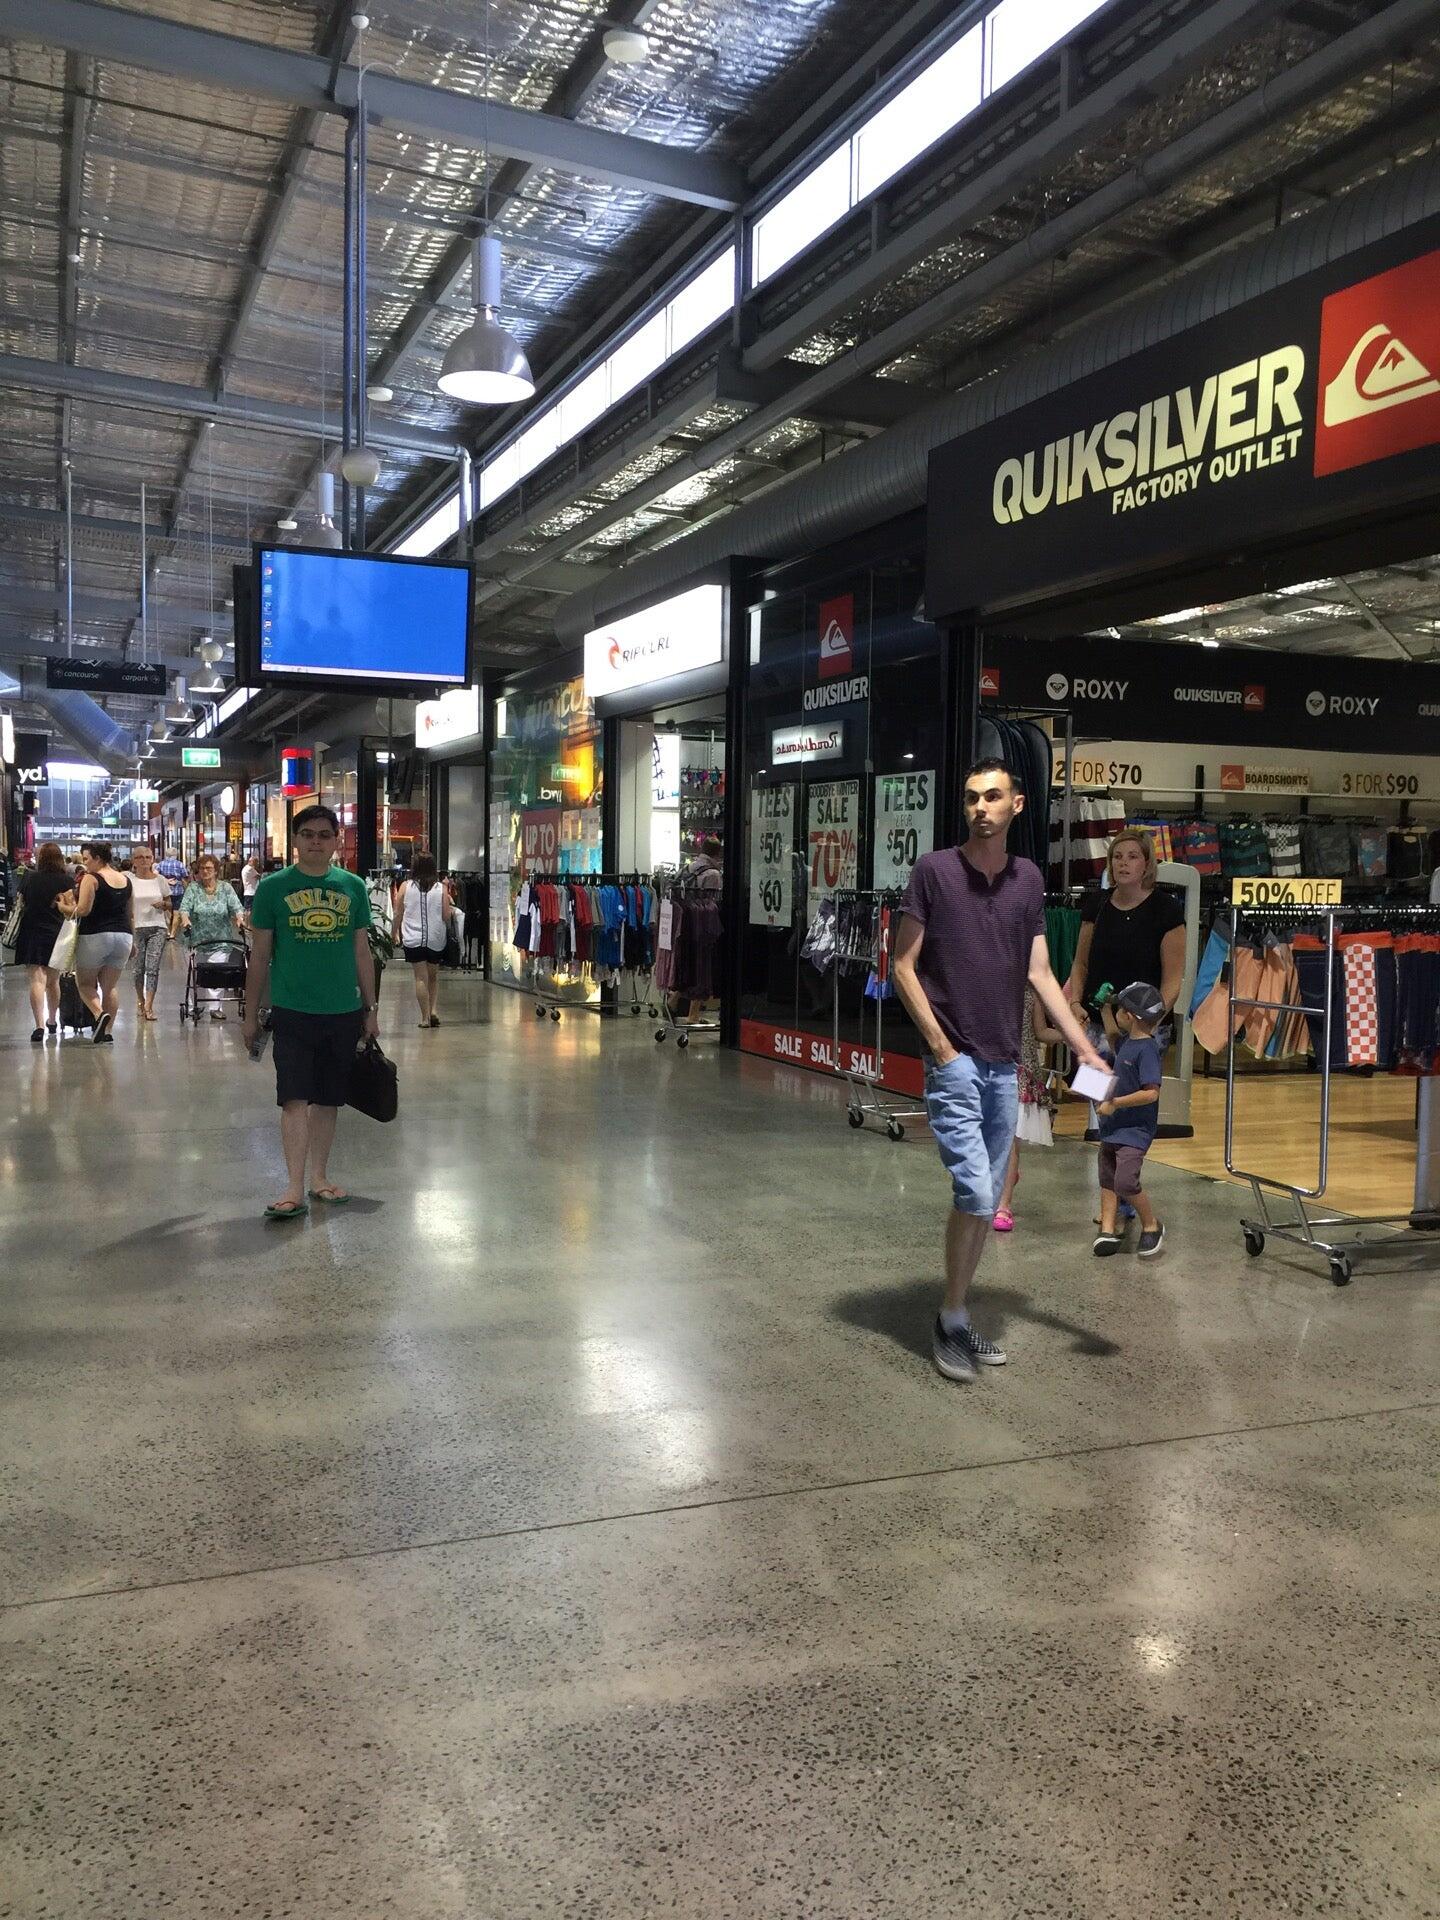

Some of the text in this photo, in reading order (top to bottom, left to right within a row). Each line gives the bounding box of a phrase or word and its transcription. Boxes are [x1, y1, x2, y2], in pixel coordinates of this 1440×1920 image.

[992, 344, 1305, 525] QUIKSILVER
[1112, 428, 1303, 515] FACTORY OUTLET
[64, 670, 100, 679] concourse
[122, 674, 149, 682] carpark
[803, 676, 868, 711] QUIKSILVER
[1073, 679, 1129, 701] ROXY
[1174, 687, 1243, 704] QUIKSILVER
[1330, 696, 1380, 716] ROXY
[1055, 760, 1143, 786] 2 FOR $70
[1245, 773, 1309, 786] BOARDSHORTS
[1342, 773, 1419, 796] 3 FOR $90
[757, 787, 791, 818] TEES
[809, 784, 836, 798] GOODBYE
[882, 774, 929, 812] TEES
[817, 797, 849, 824] SALE
[525, 825, 538, 855] UP
[539, 823, 554, 855] TO
[810, 829, 857, 888] 70%
[840, 864, 857, 888] OFF
[1241, 882, 1336, 905] 50% OFF
[774, 1033, 802, 1058] SALE
